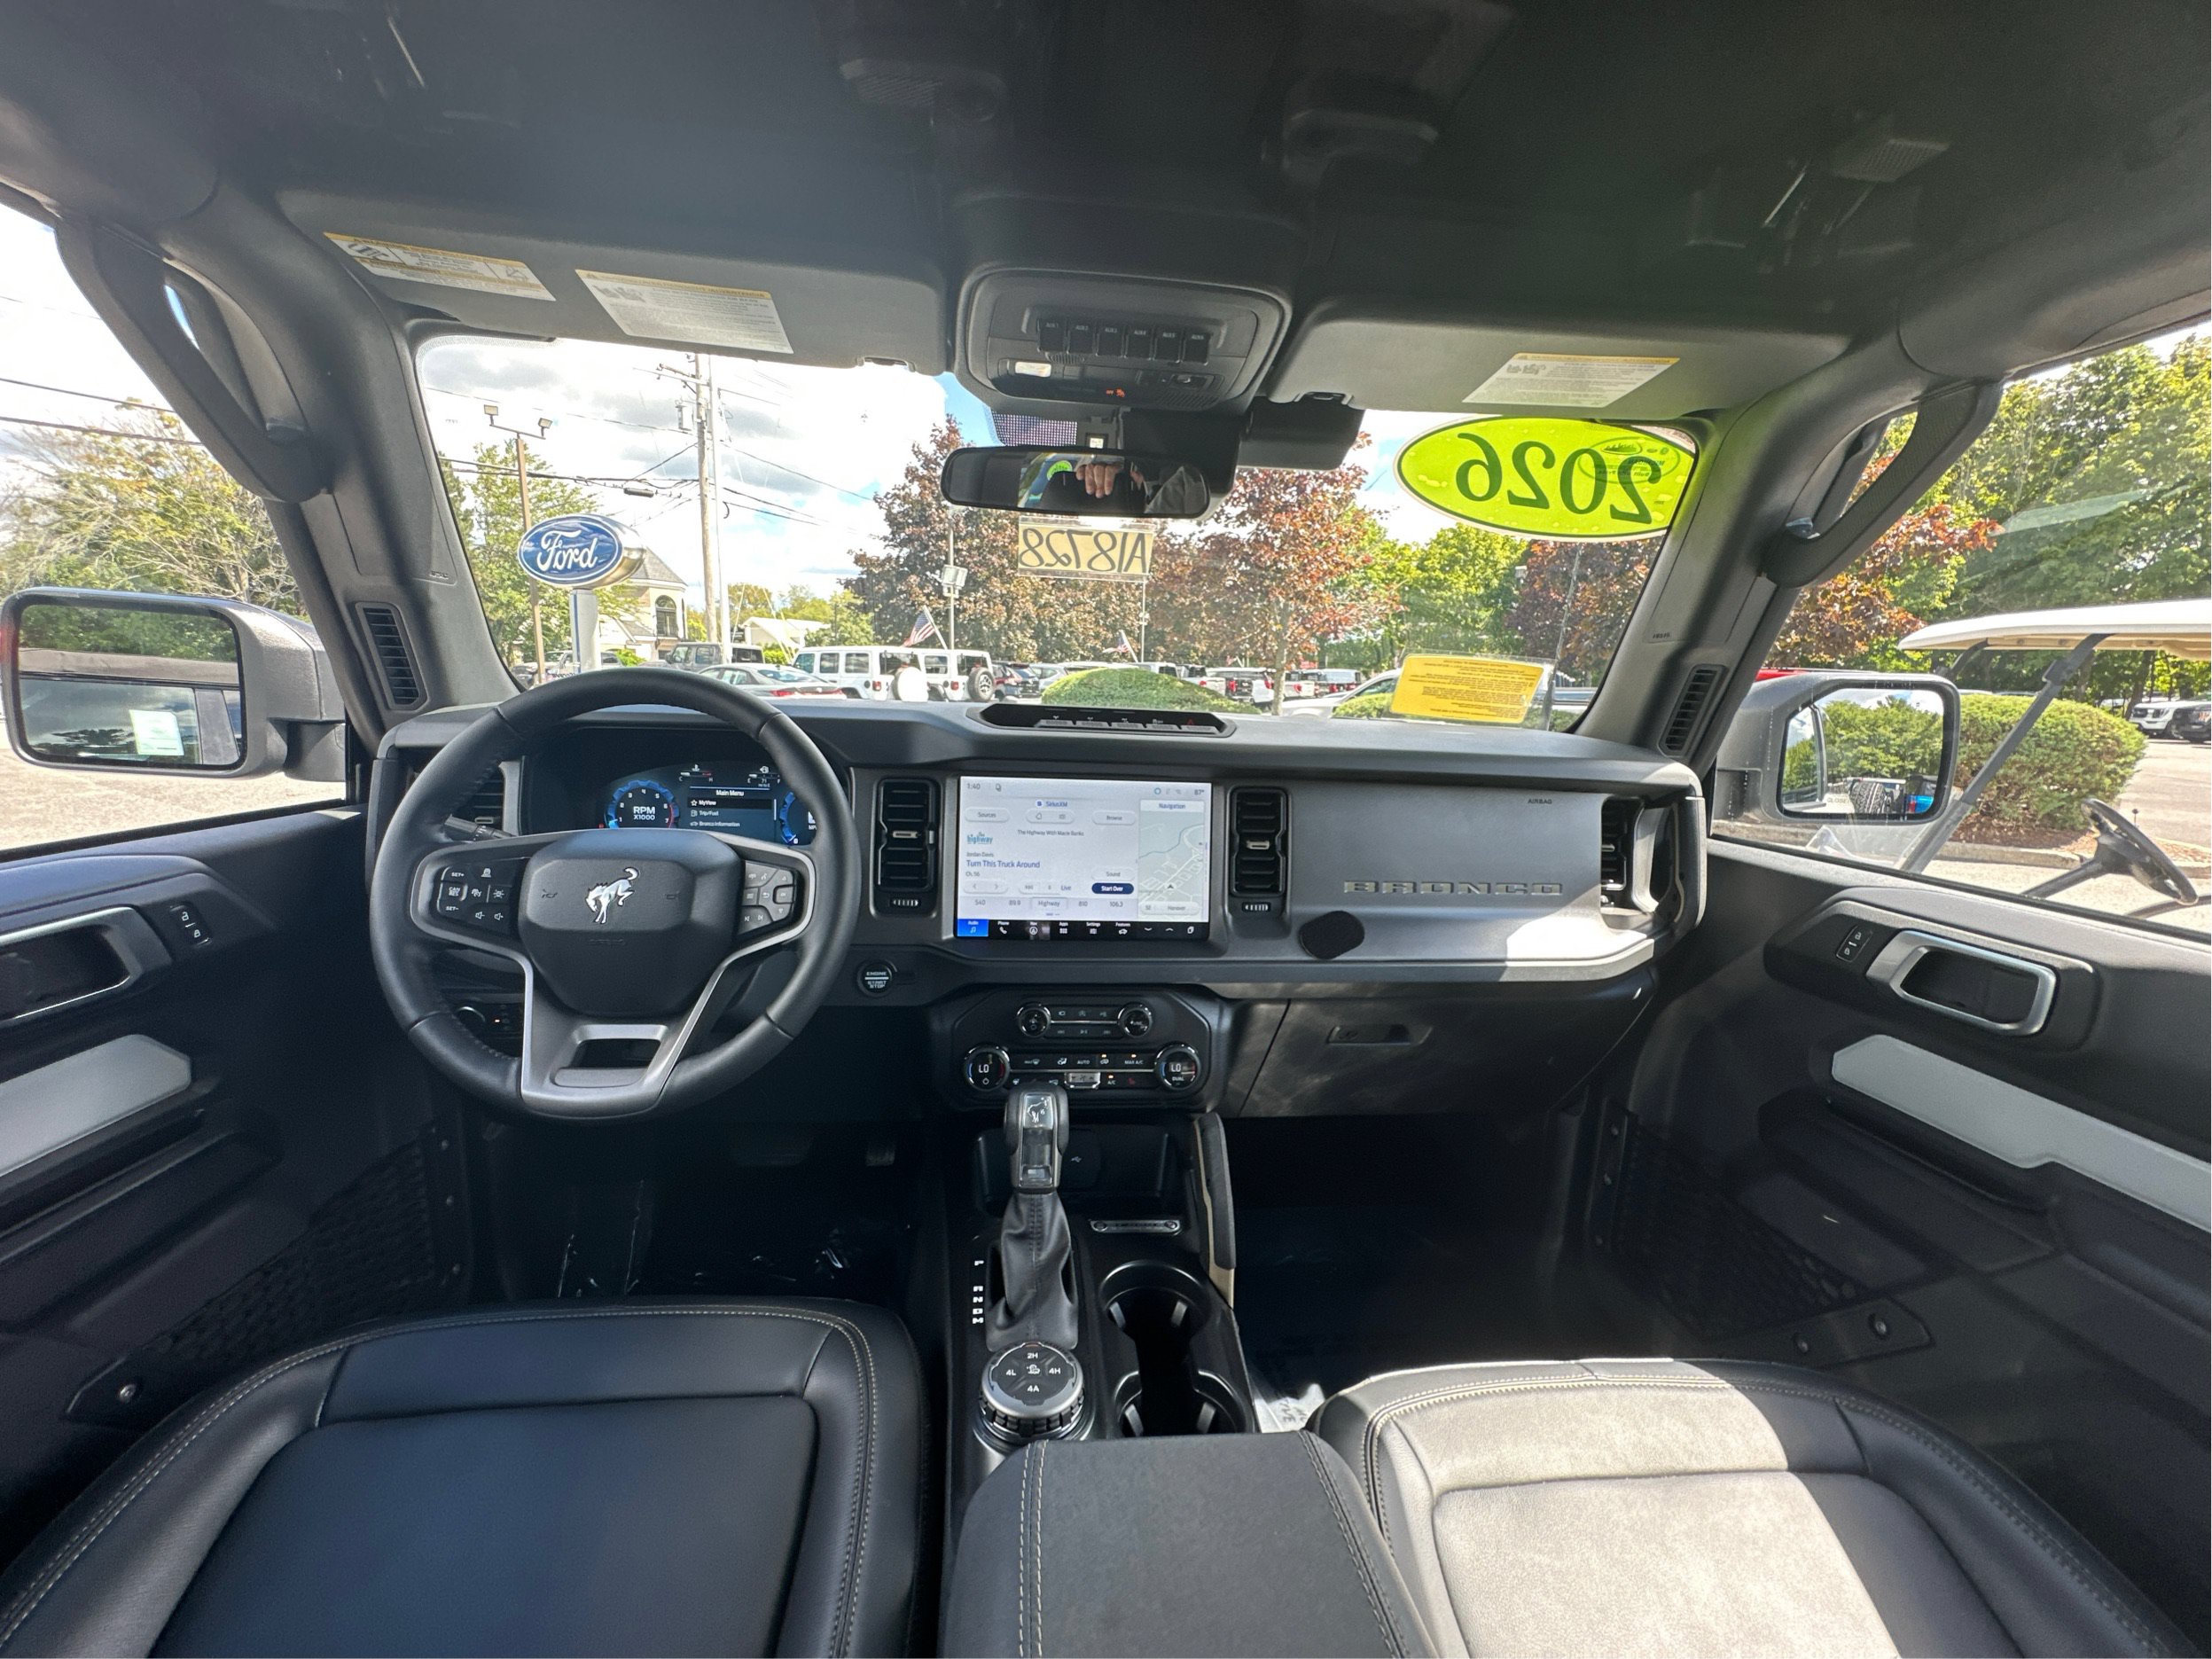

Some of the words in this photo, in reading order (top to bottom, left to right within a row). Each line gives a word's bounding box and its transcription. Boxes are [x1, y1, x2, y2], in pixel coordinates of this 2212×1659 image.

[536, 529, 598, 572] Ford
[633, 806, 655, 815] RPM
[967, 834, 993, 844] highway
[1344, 881, 1563, 896] BRONCO
